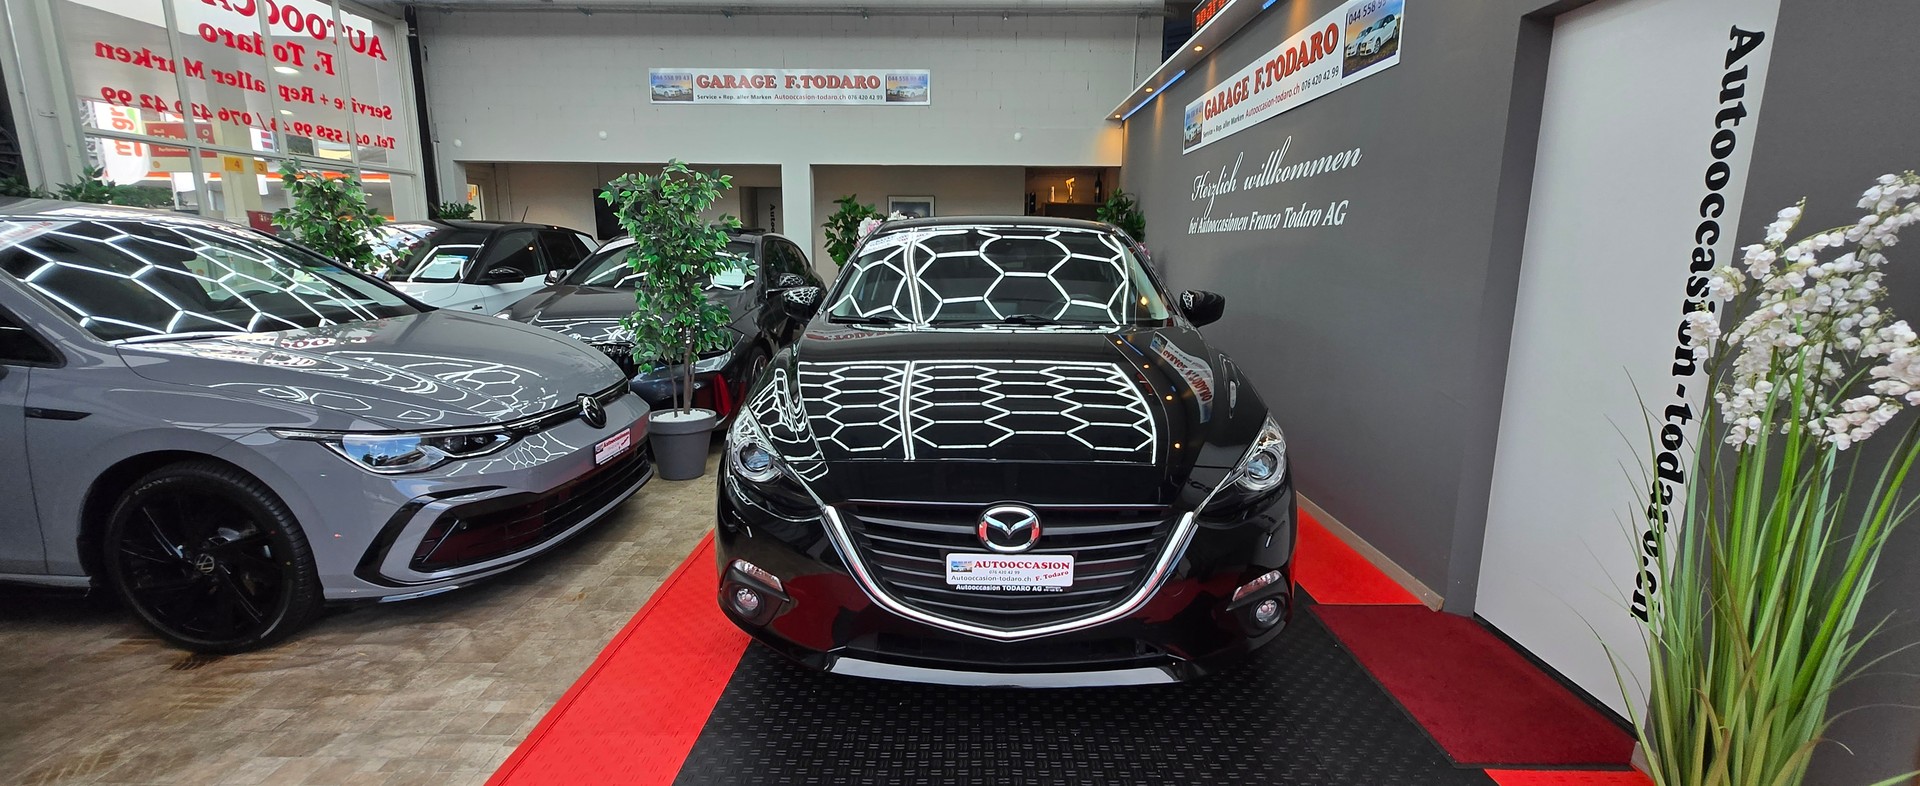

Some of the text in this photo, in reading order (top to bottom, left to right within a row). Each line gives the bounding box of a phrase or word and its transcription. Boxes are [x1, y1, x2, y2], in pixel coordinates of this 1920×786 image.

[696, 74, 881, 89] GARAGE F.TODARO
[1205, 22, 1340, 120] GARAGE F.TODARO
[1245, 83, 1300, 119] Autooccasion-todaro.ch
[1301, 79, 1311, 91] 076
[1312, 73, 1322, 87] 420
[1323, 69, 1331, 81] 42
[1332, 66, 1340, 78] 99
[1191, 135, 1363, 220] Herzlich willkommen
[1188, 200, 1349, 235] bei Autooccasionen Franco Todaro AG
[974, 560, 1070, 569] AUTOOCCASION
[1044, 570, 1069, 580] Todaro
